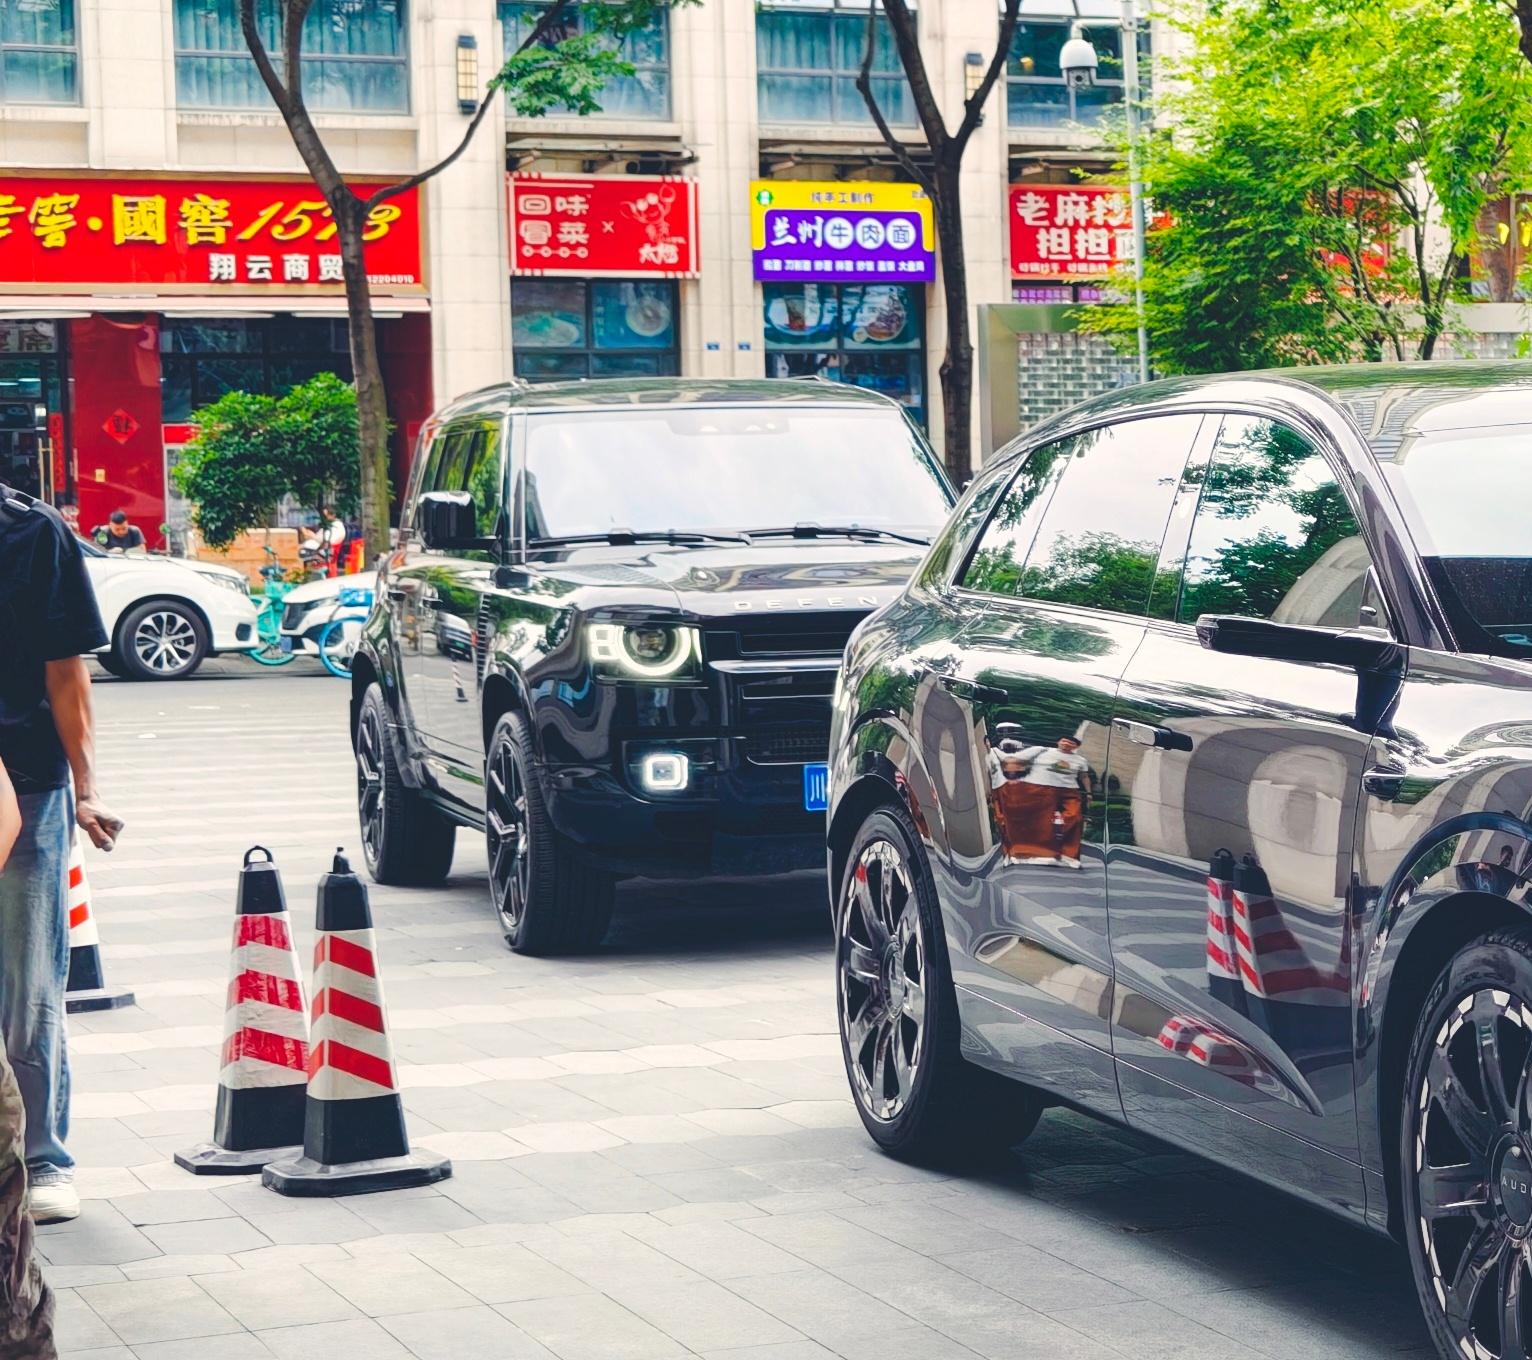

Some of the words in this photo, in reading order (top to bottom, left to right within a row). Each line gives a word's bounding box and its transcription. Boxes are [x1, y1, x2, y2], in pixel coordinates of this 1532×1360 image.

[518, 194, 590, 217] 回味
[769, 214, 914, 249] 兰州牛肉面
[208, 252, 344, 282] 翔云商贸
[734, 595, 893, 611] DEFEN
